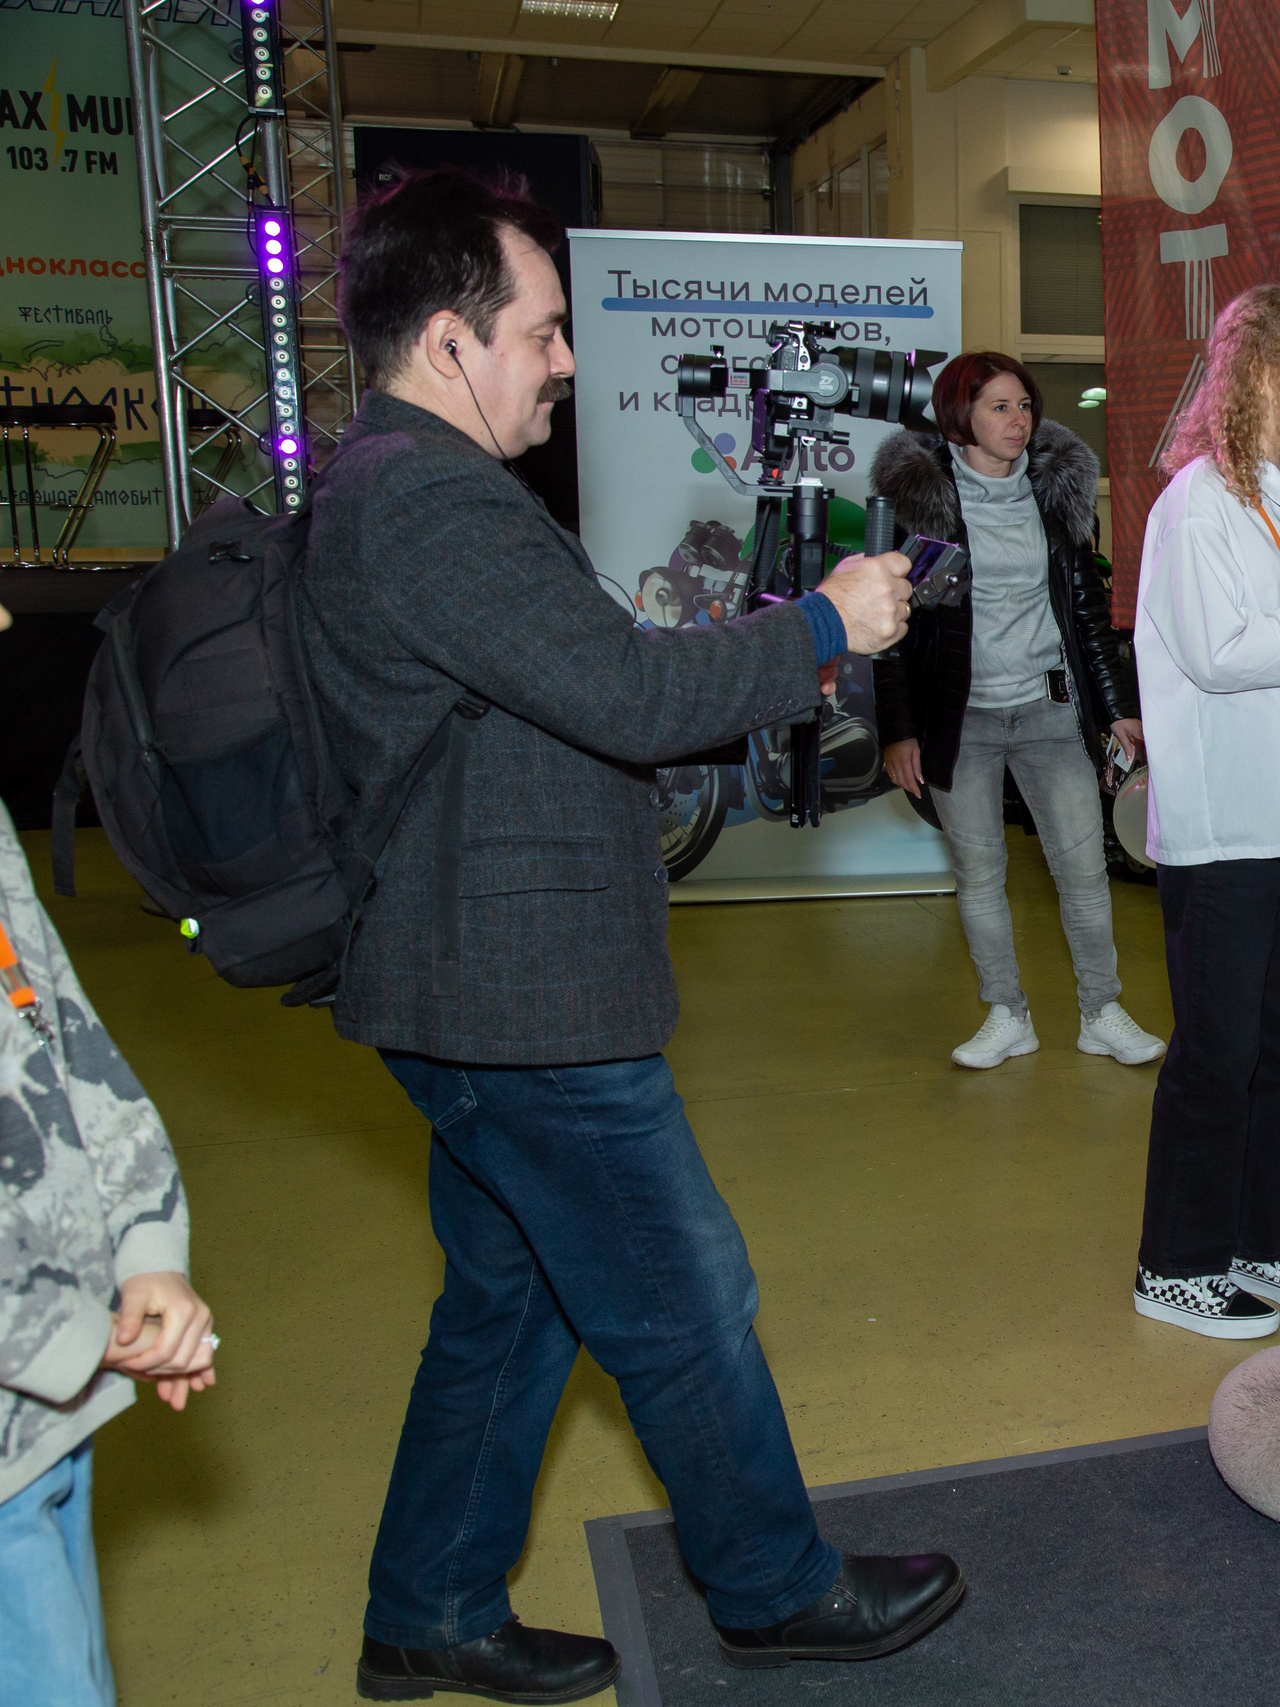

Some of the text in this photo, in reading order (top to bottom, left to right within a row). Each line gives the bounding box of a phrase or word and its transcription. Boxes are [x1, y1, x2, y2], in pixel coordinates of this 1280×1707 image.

[85, 150, 118, 175] FM
[607, 269, 929, 309] Тысячи моделей
[18, 304, 114, 326] ФЕСТИВАЛЬ
[651, 316, 891, 346] мотоцов,
[619, 391, 640, 412] и
